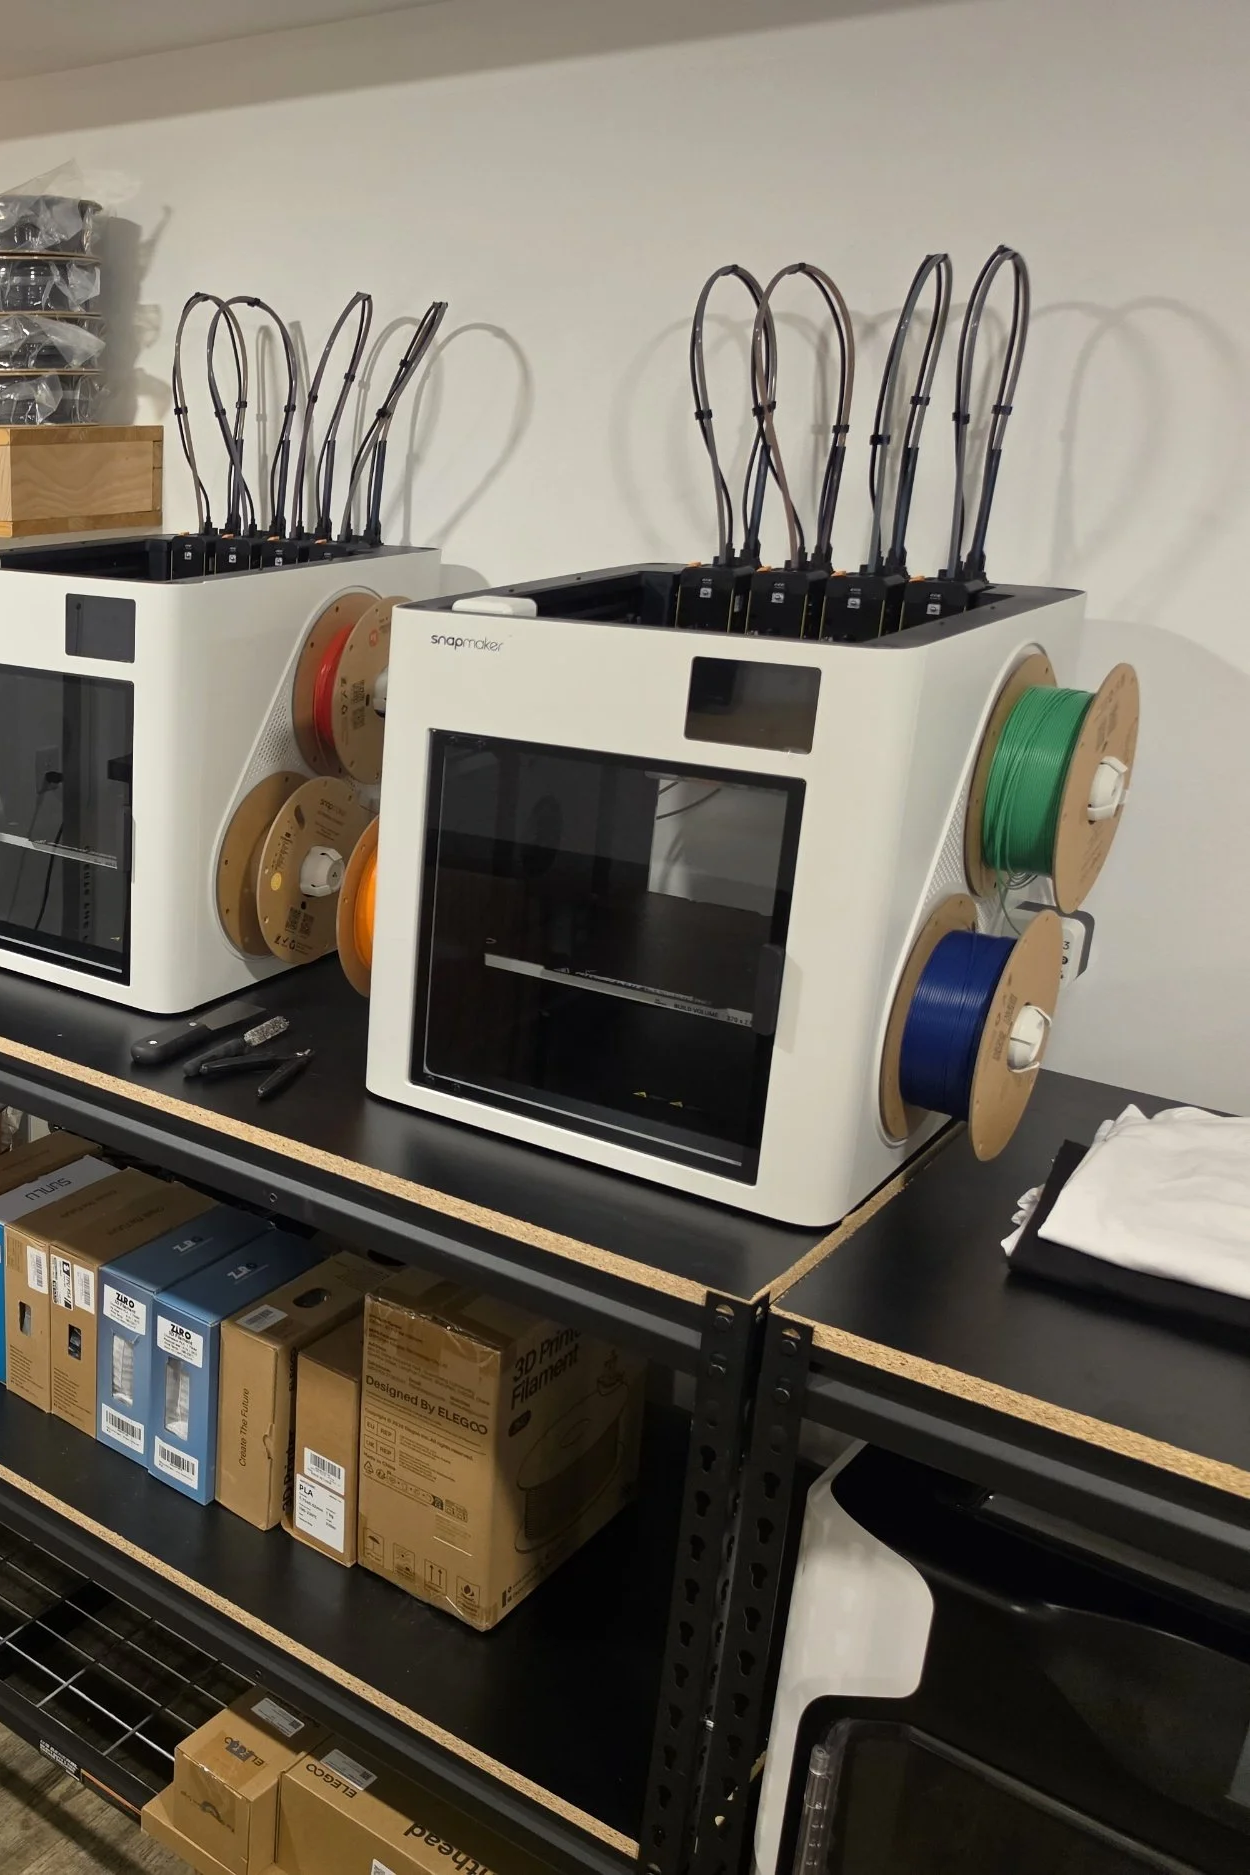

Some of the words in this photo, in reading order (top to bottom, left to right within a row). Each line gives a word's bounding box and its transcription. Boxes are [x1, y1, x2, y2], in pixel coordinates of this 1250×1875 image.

[431, 634, 504, 652] snapmaker
[25, 1177, 72, 1200] SUNLU
[513, 1349, 536, 1382] 3D
[540, 1328, 581, 1364] Print
[511, 1342, 579, 1411] Filament
[241, 1388, 250, 1419] Future
[365, 1374, 419, 1406] Designed
[420, 1399, 436, 1415] By
[437, 1407, 488, 1436] ELEGOO
[239, 1437, 247, 1468] Create
[299, 1484, 313, 1498] PLA
[305, 1763, 357, 1799] ELEGOO
[402, 1823, 490, 1875] thead
